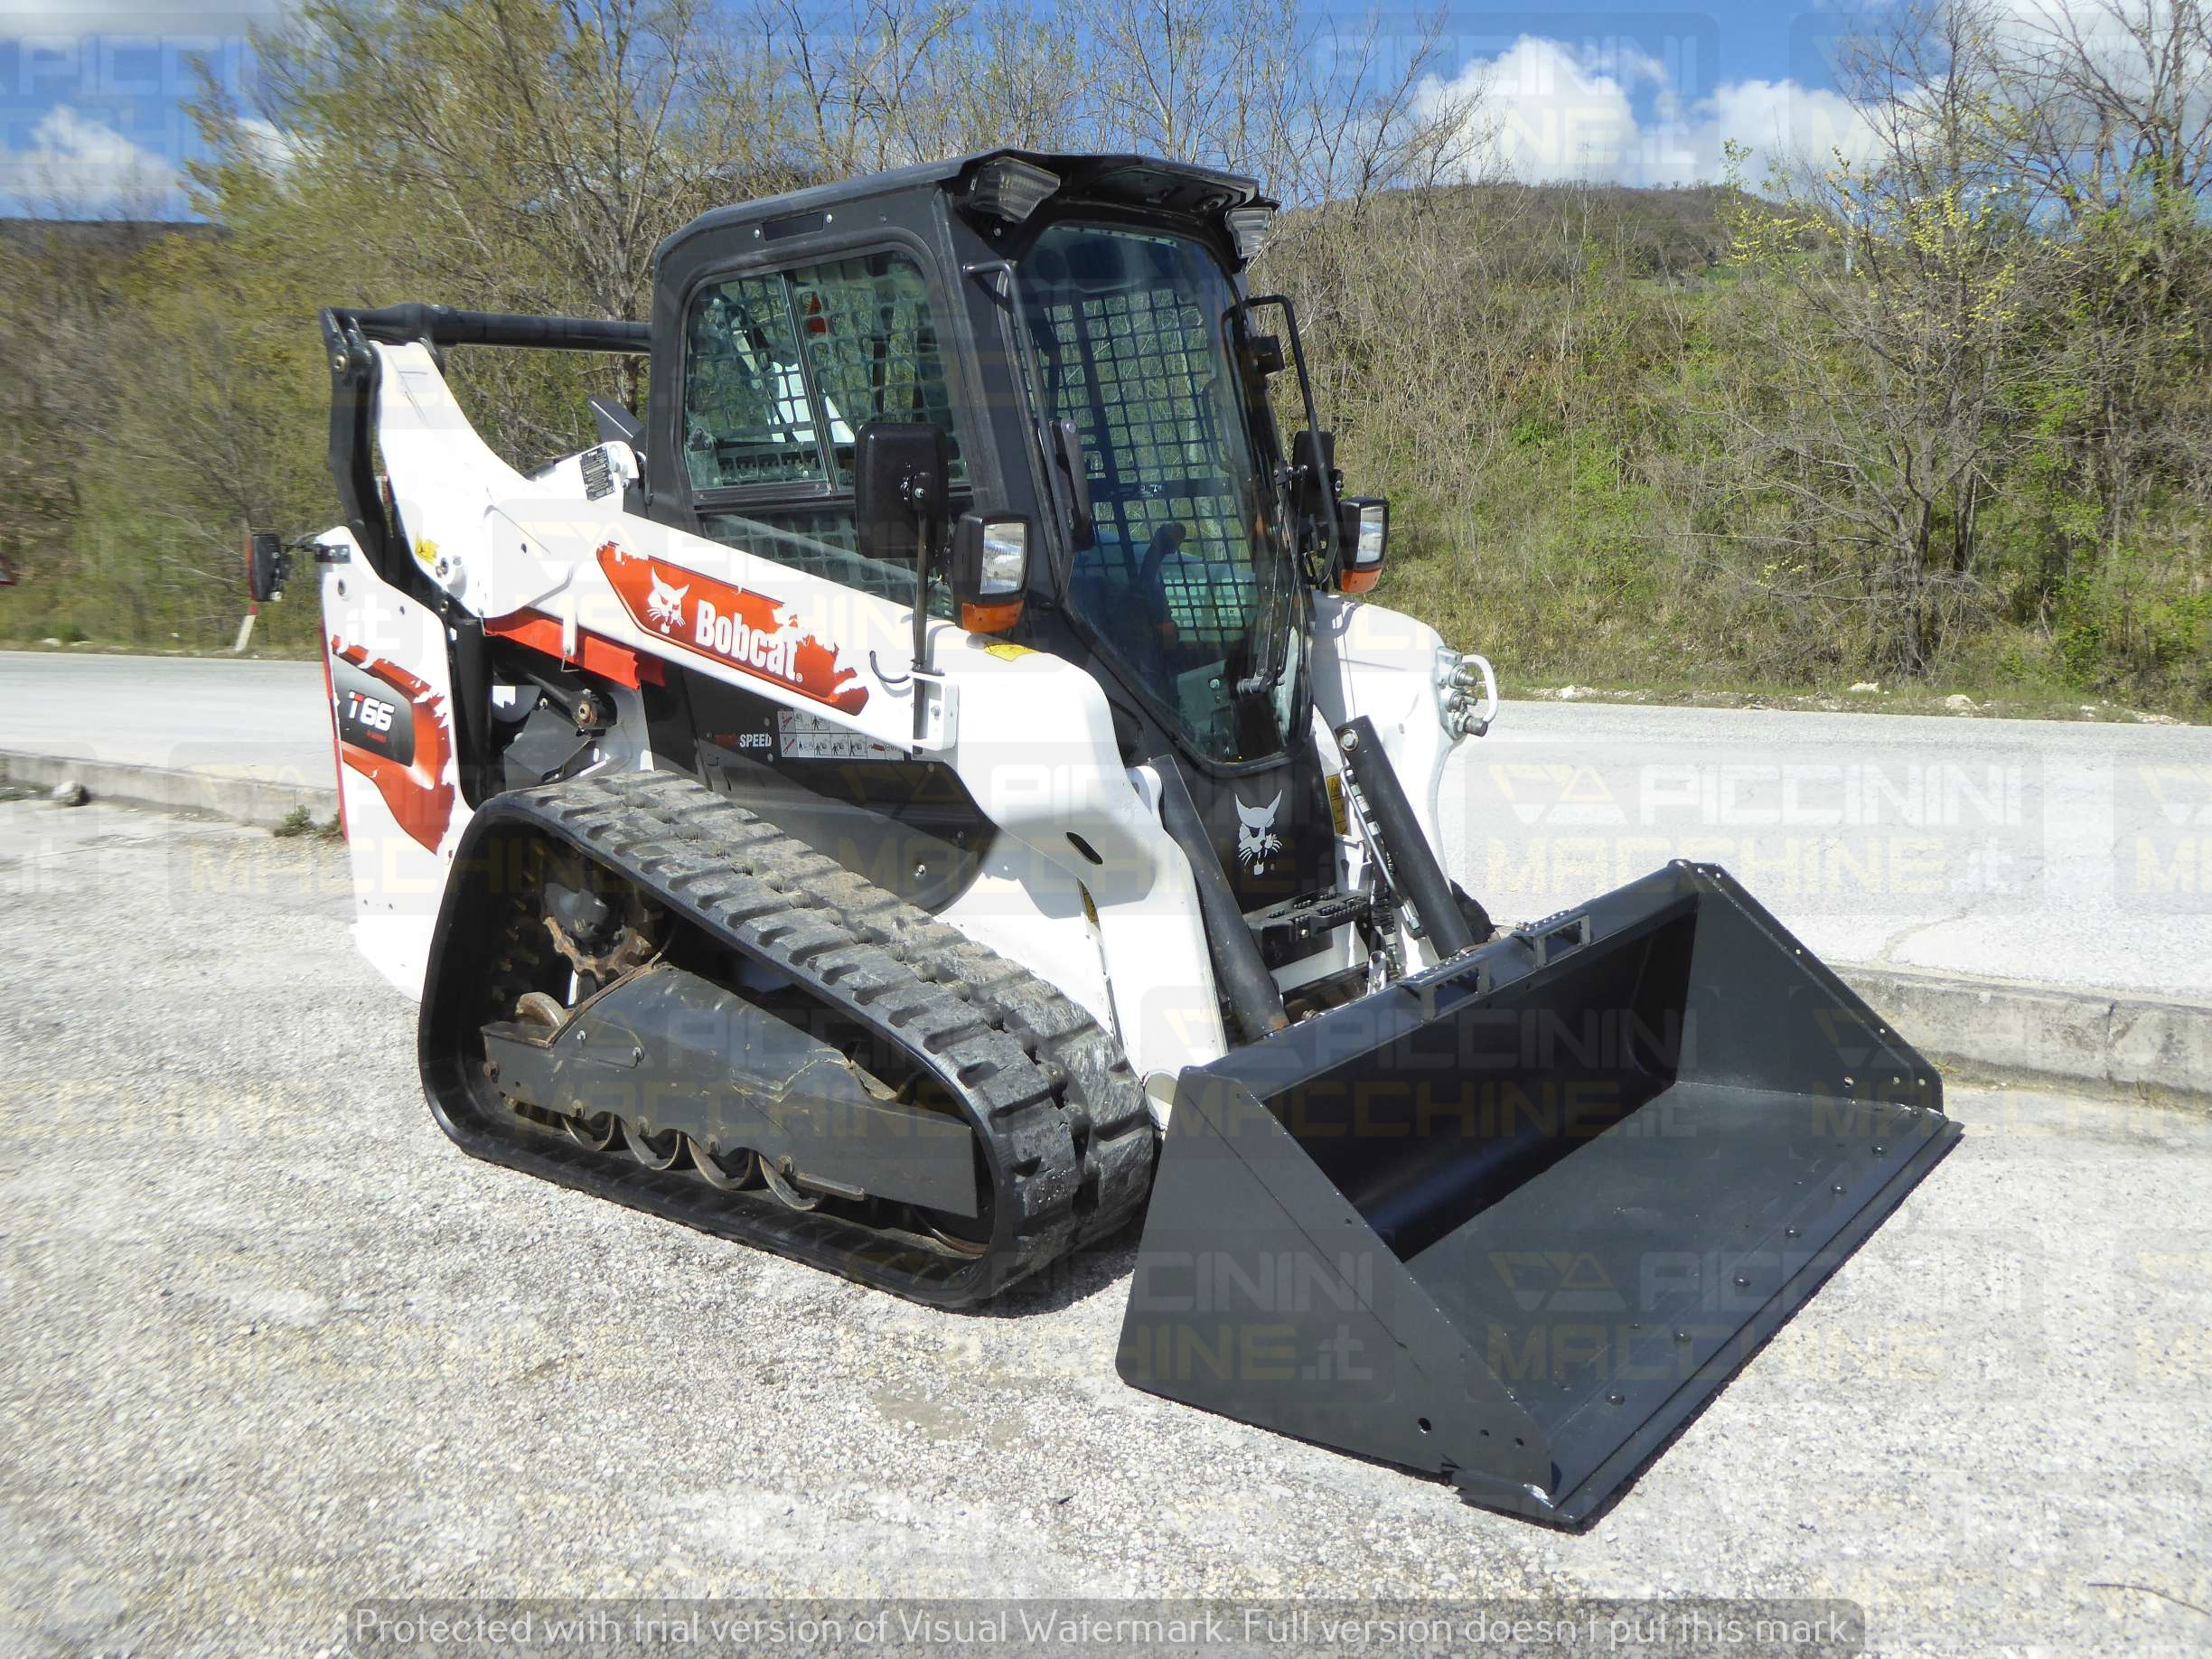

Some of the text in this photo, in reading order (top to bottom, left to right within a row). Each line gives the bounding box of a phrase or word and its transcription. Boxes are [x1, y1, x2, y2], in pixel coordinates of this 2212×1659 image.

[695, 598, 797, 680] Bobcat
[348, 690, 395, 732] T66
[739, 733, 773, 748] SPEED
